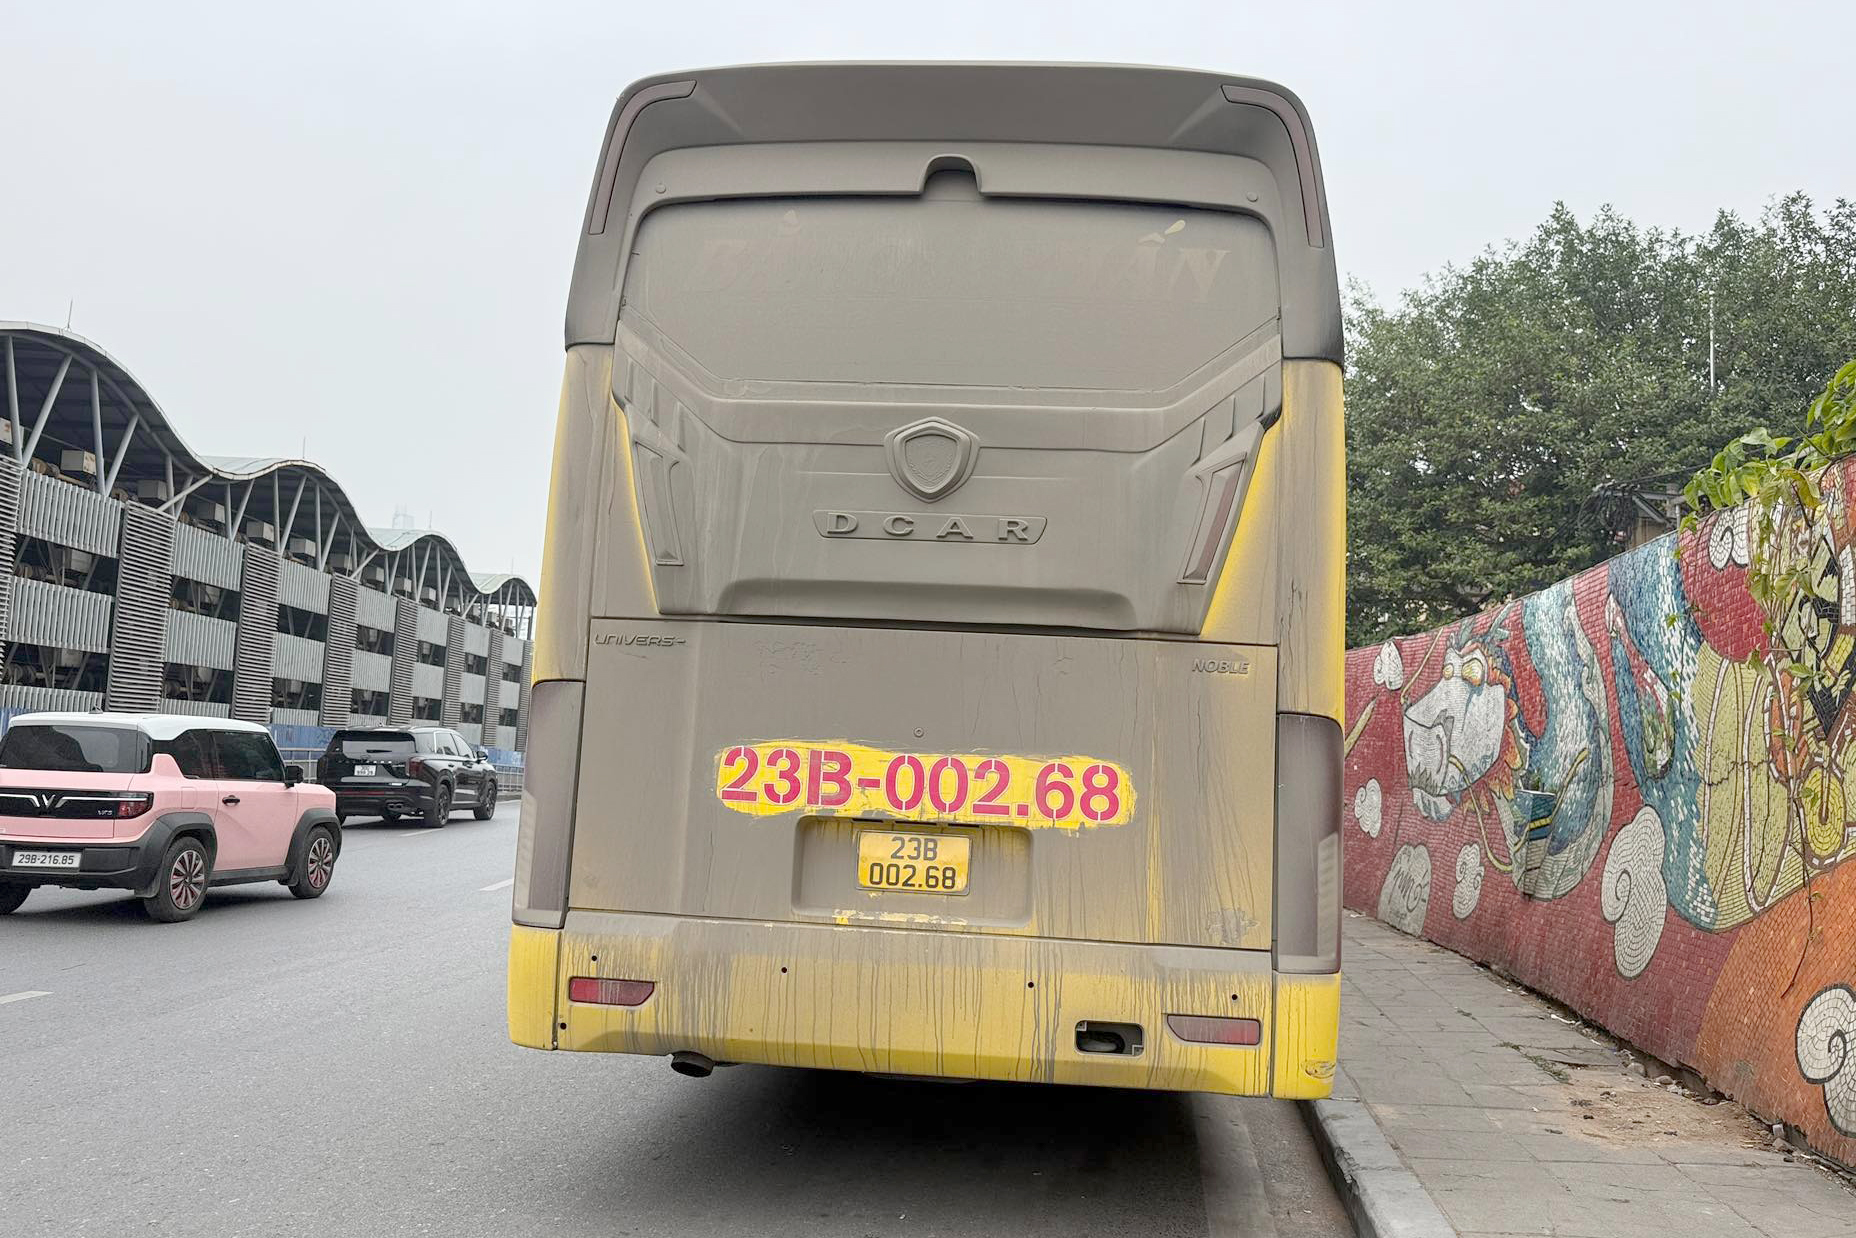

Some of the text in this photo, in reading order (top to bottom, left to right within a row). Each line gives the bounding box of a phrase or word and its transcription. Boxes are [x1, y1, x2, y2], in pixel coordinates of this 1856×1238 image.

[827, 512, 1029, 542] DCAR
[1192, 659, 1249, 674] NOBLE
[720, 745, 1121, 822] 23B-002.68
[891, 836, 938, 861] 23B
[869, 862, 956, 890] 002.68
